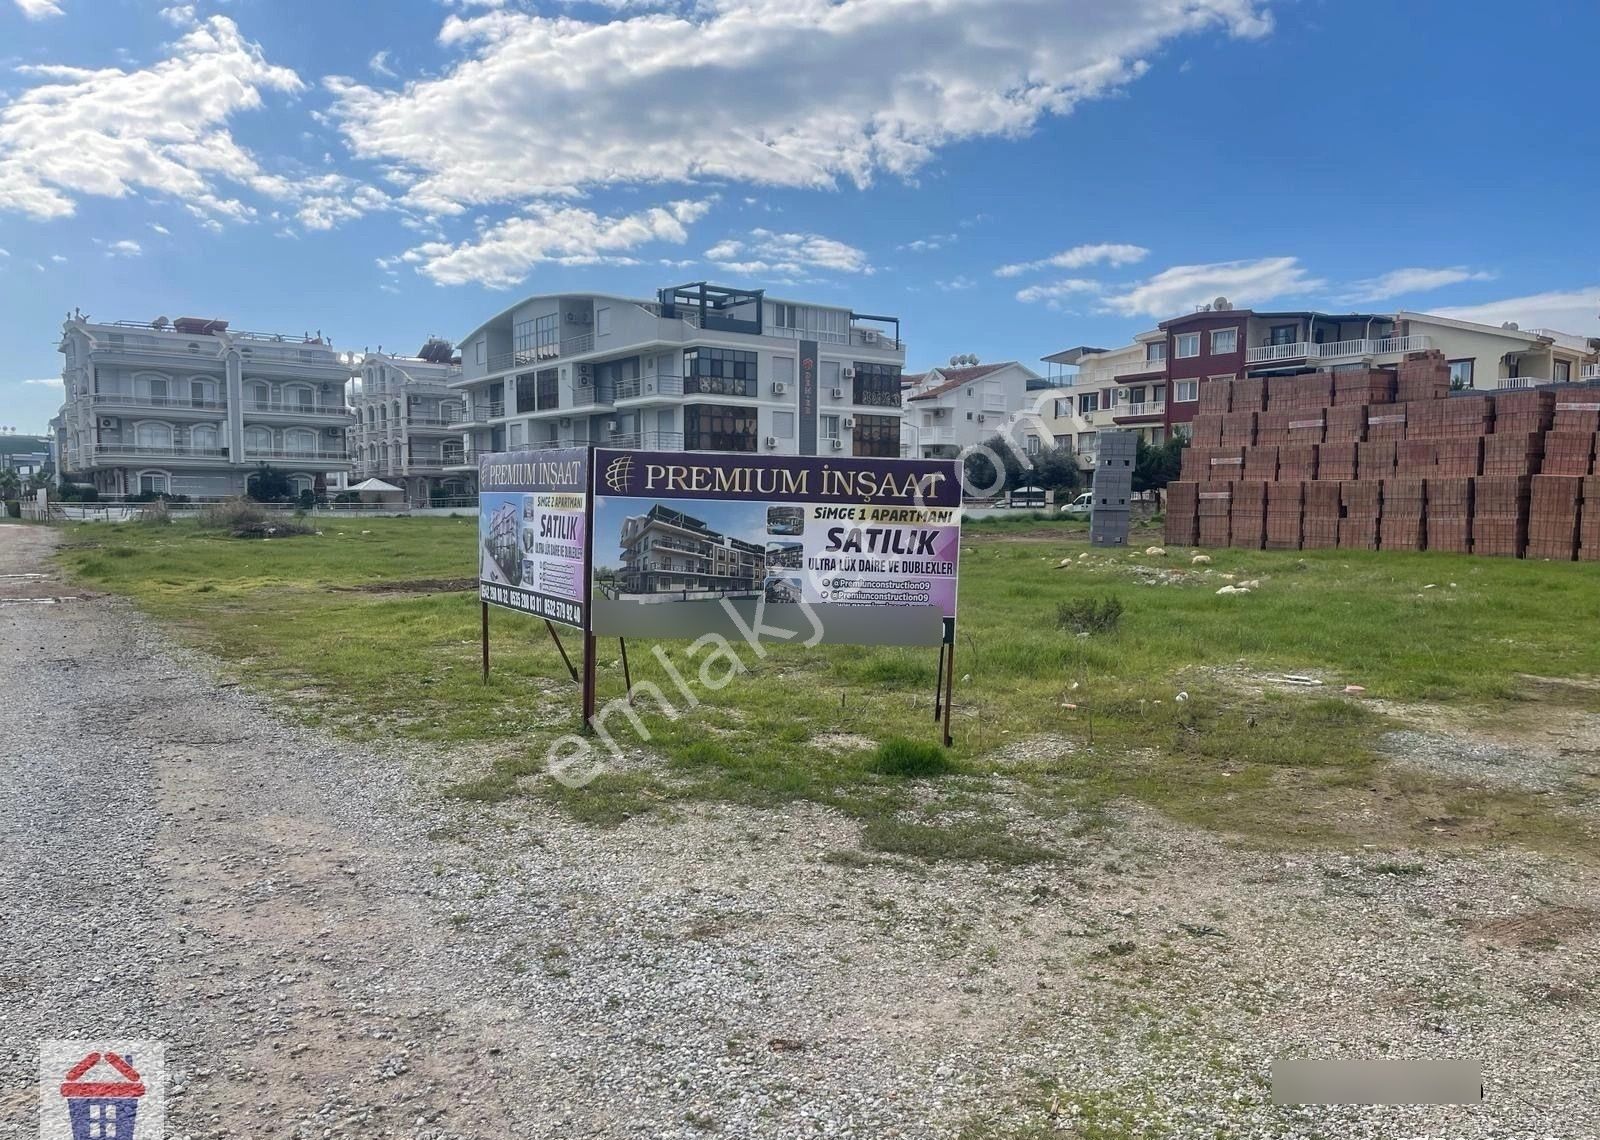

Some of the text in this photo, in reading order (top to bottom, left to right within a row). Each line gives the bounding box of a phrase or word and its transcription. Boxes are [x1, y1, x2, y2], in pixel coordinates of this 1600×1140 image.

[489, 457, 581, 491] PREMIUM İNŞAAT
[645, 464, 945, 502] PREMIUM İNŞAAT
[555, 496, 583, 509] APARTMANI
[814, 507, 953, 523] SİMGE 1 APARTMANI
[540, 514, 578, 541] SATILIK
[825, 527, 940, 556] SATILIK
[808, 557, 953, 575] ULTRA LÜX DAİRE VE DUBLEXLER
